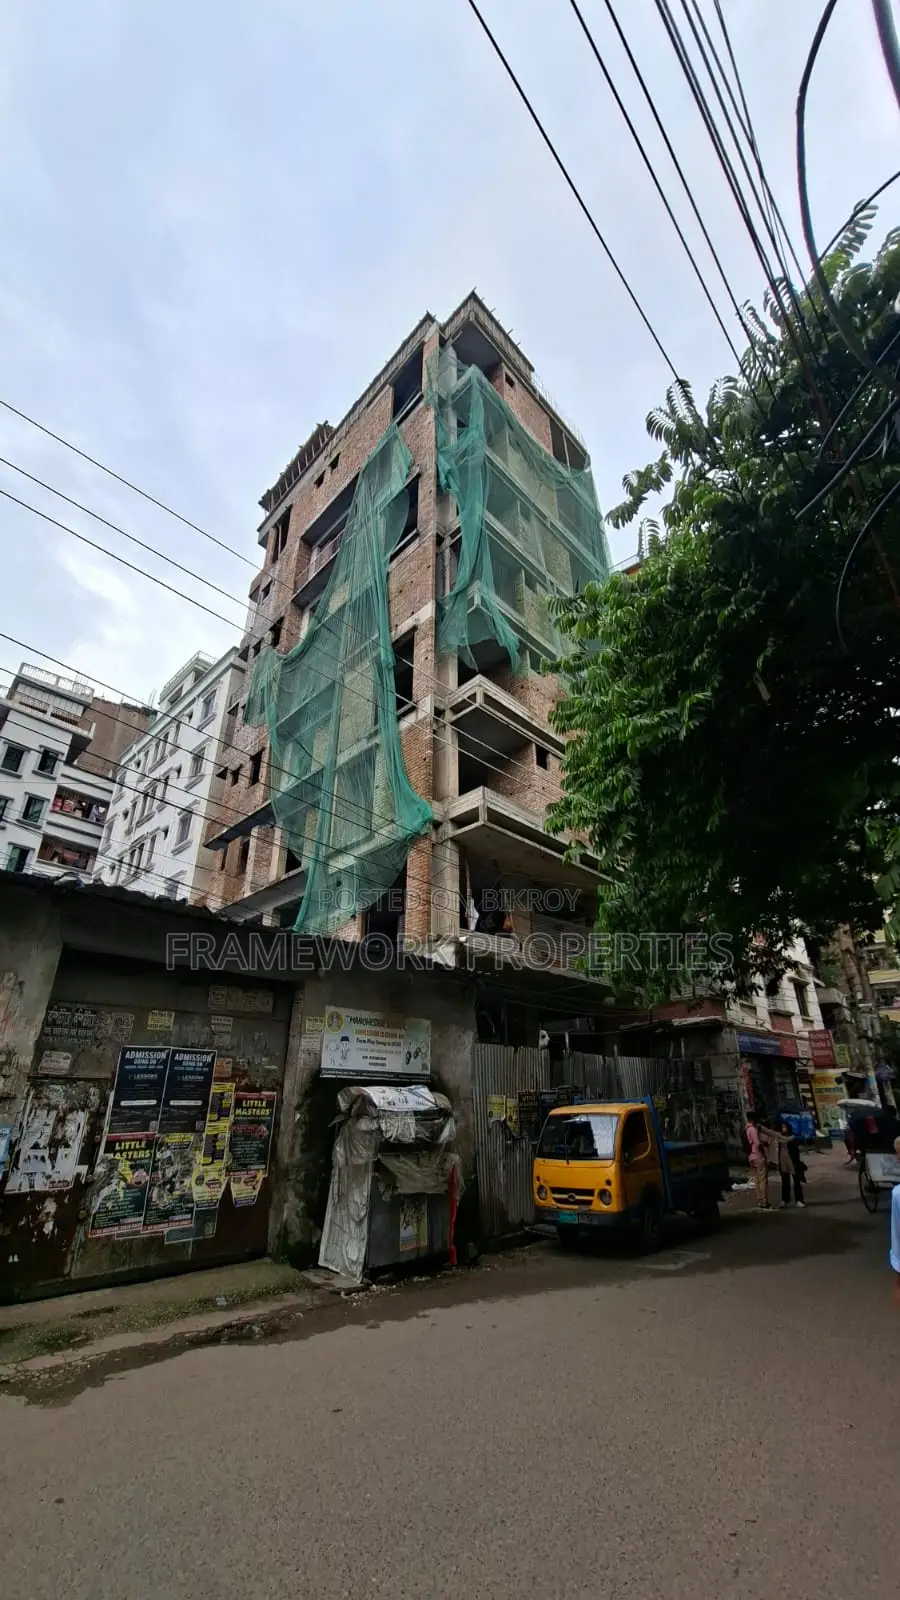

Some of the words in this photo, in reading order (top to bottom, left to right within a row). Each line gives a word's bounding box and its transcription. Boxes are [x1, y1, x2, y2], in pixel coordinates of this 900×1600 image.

[125, 1050, 167, 1060] ADMISSION
[174, 1053, 212, 1063] ADMISSION
[242, 1099, 267, 1107] LITTLE
[115, 1140, 147, 1150] LITTLE
